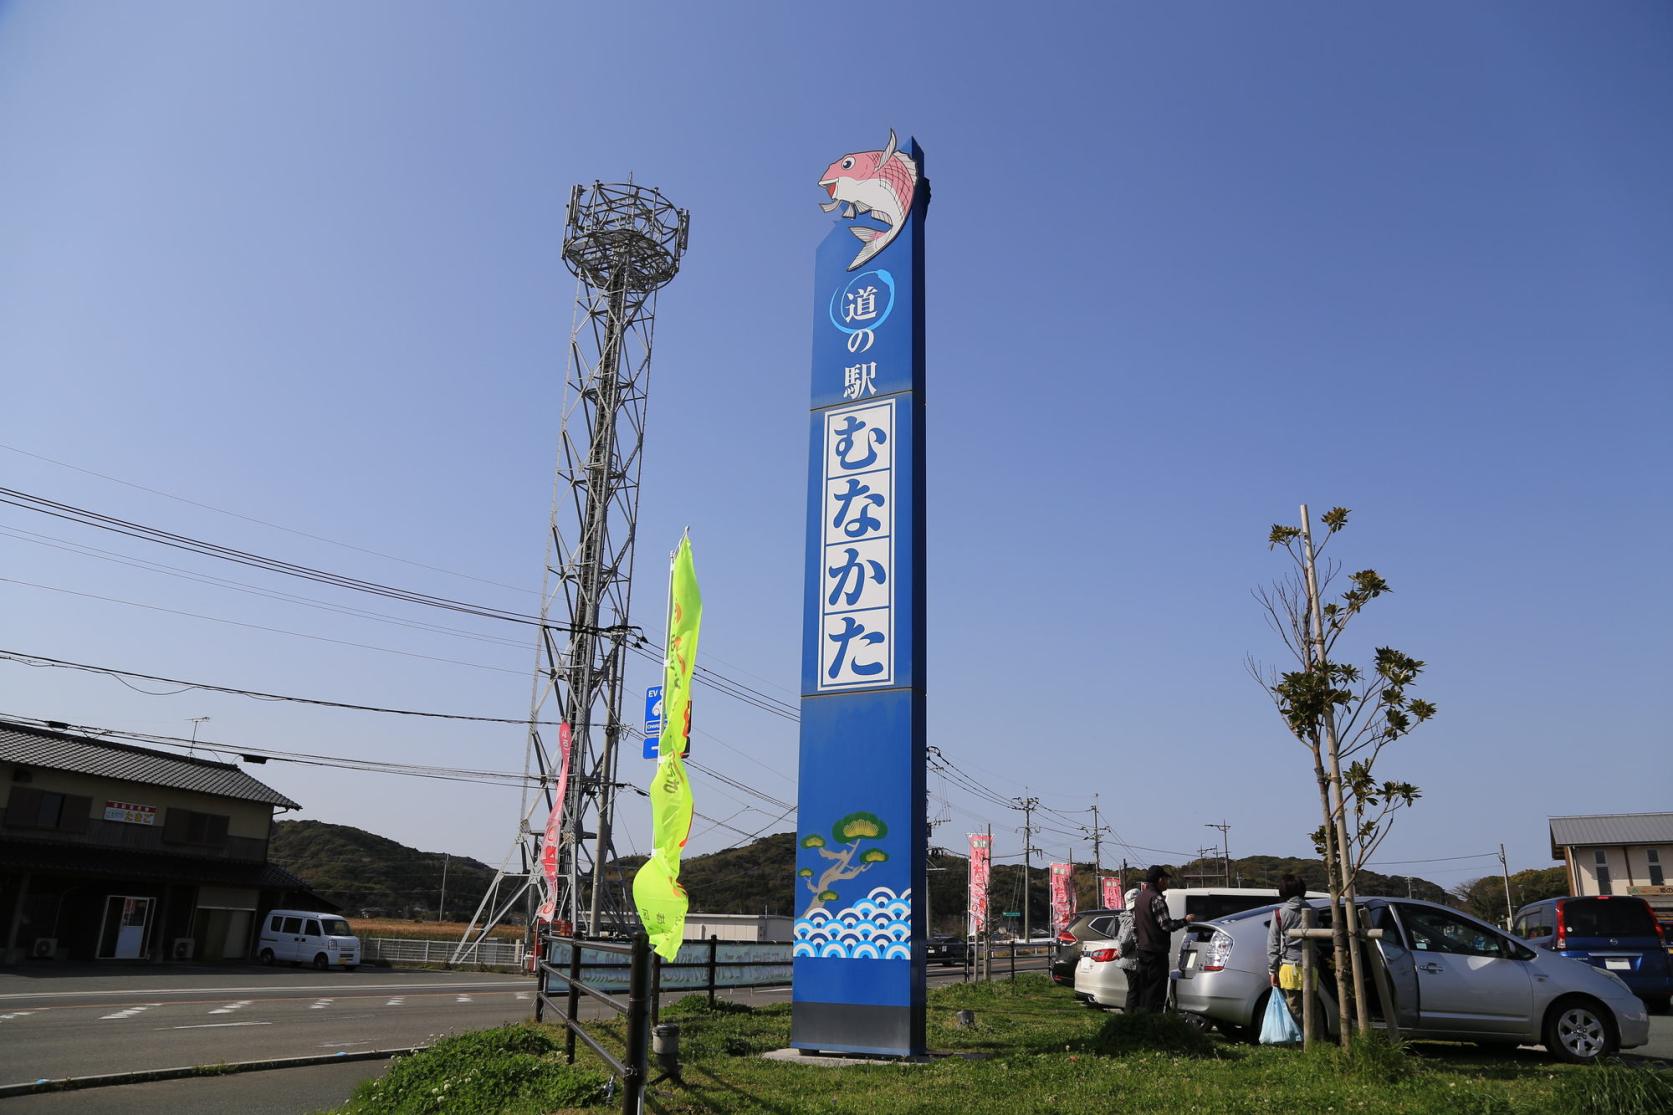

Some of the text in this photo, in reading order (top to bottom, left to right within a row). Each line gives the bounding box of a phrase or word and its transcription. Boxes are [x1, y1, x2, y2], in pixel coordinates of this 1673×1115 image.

[842, 286, 878, 400] 道の駅
[827, 415, 887, 680] むなかた
[648, 690, 658, 698] EV
